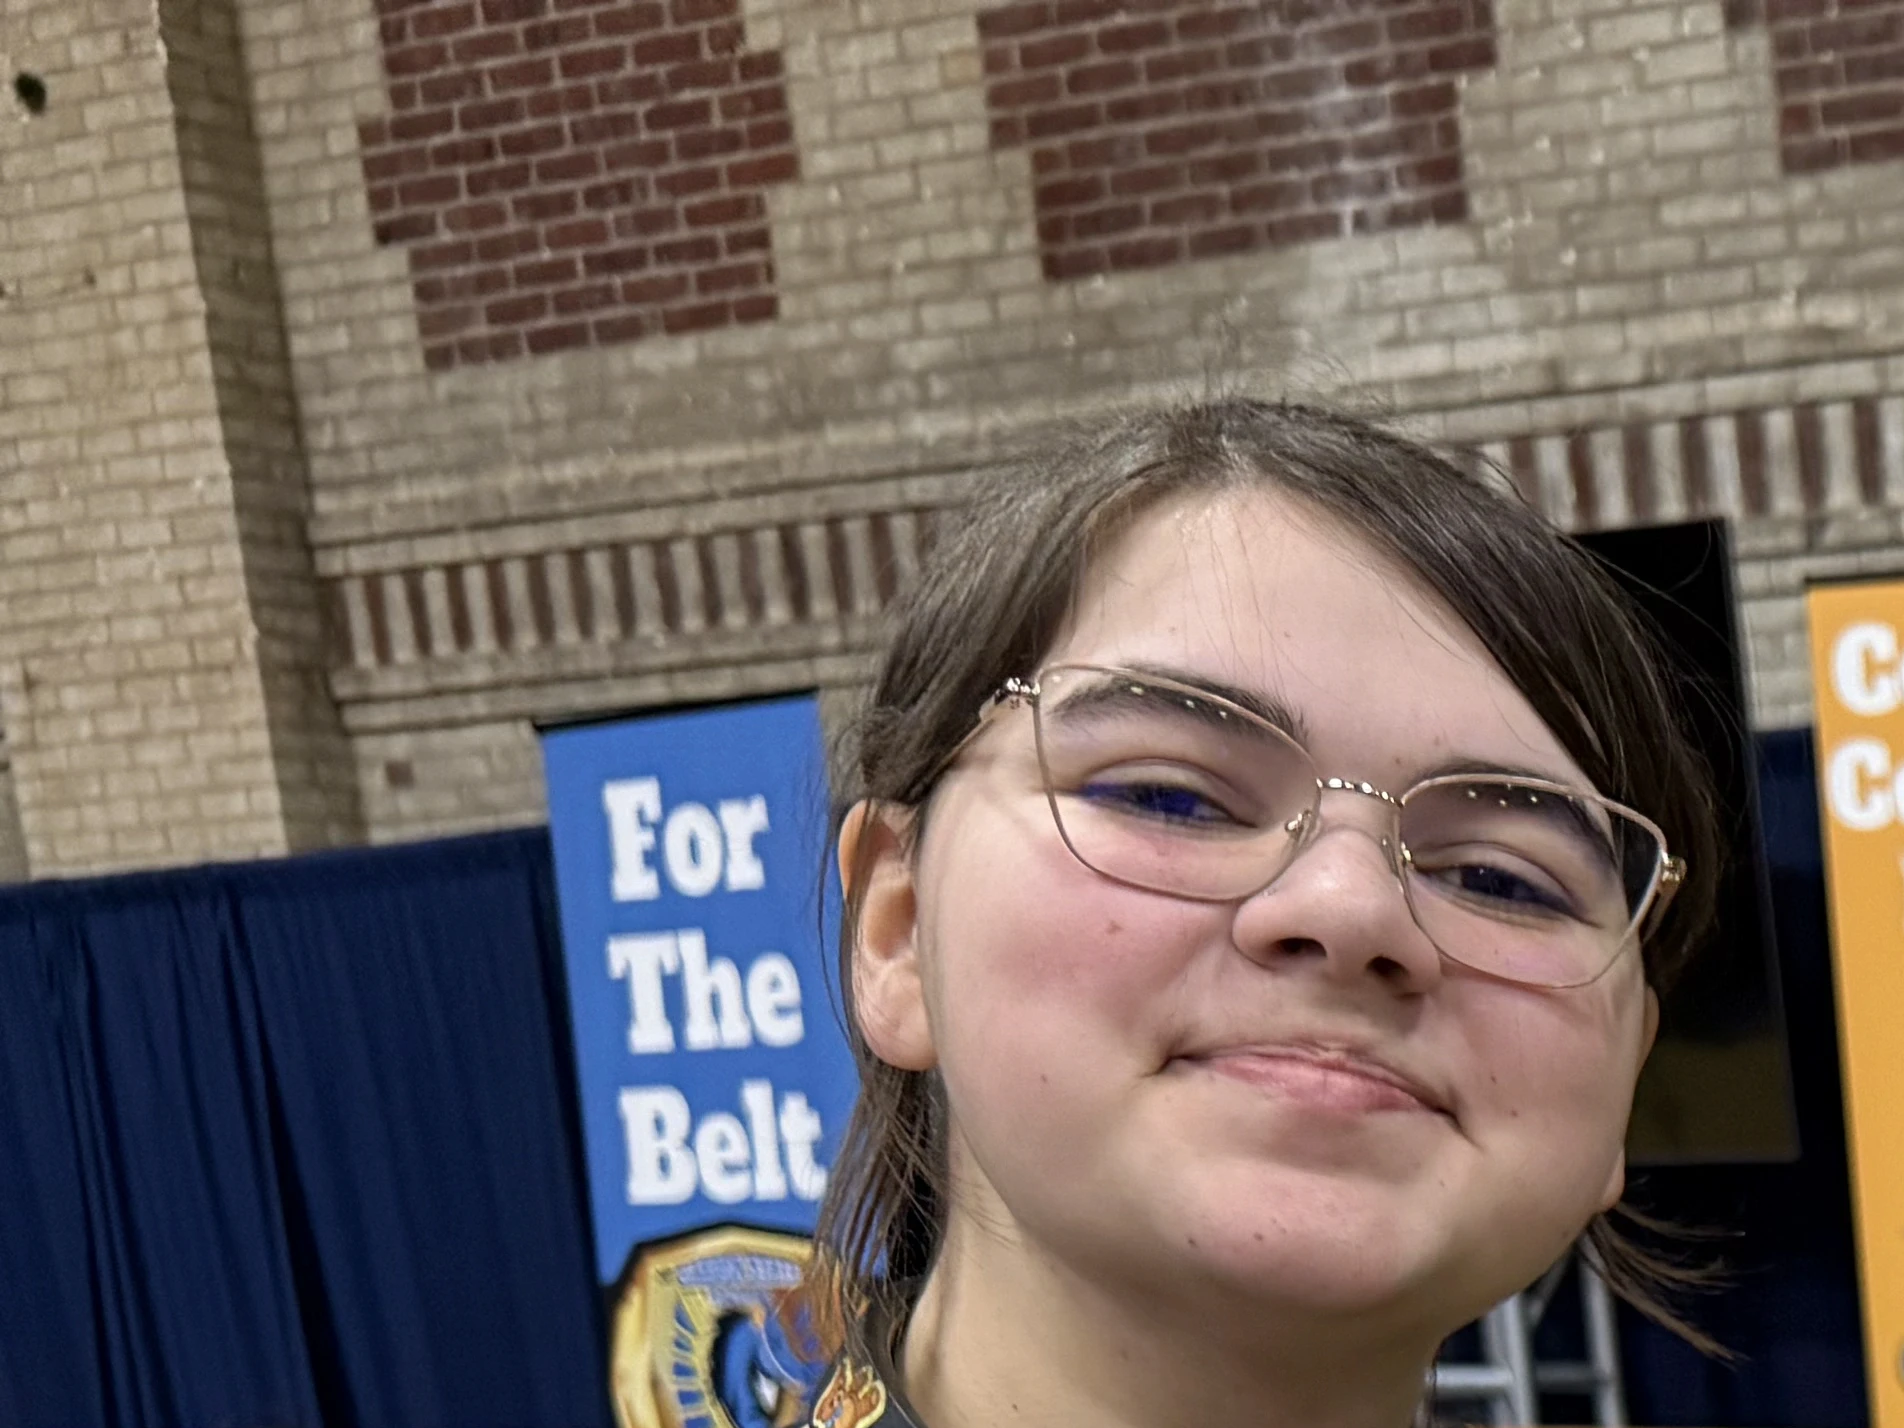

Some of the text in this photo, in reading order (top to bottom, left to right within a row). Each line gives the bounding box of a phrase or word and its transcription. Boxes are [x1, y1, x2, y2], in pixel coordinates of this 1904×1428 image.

[603, 775, 770, 903] For
[608, 929, 804, 1055] The
[619, 1078, 828, 1205] Belt
